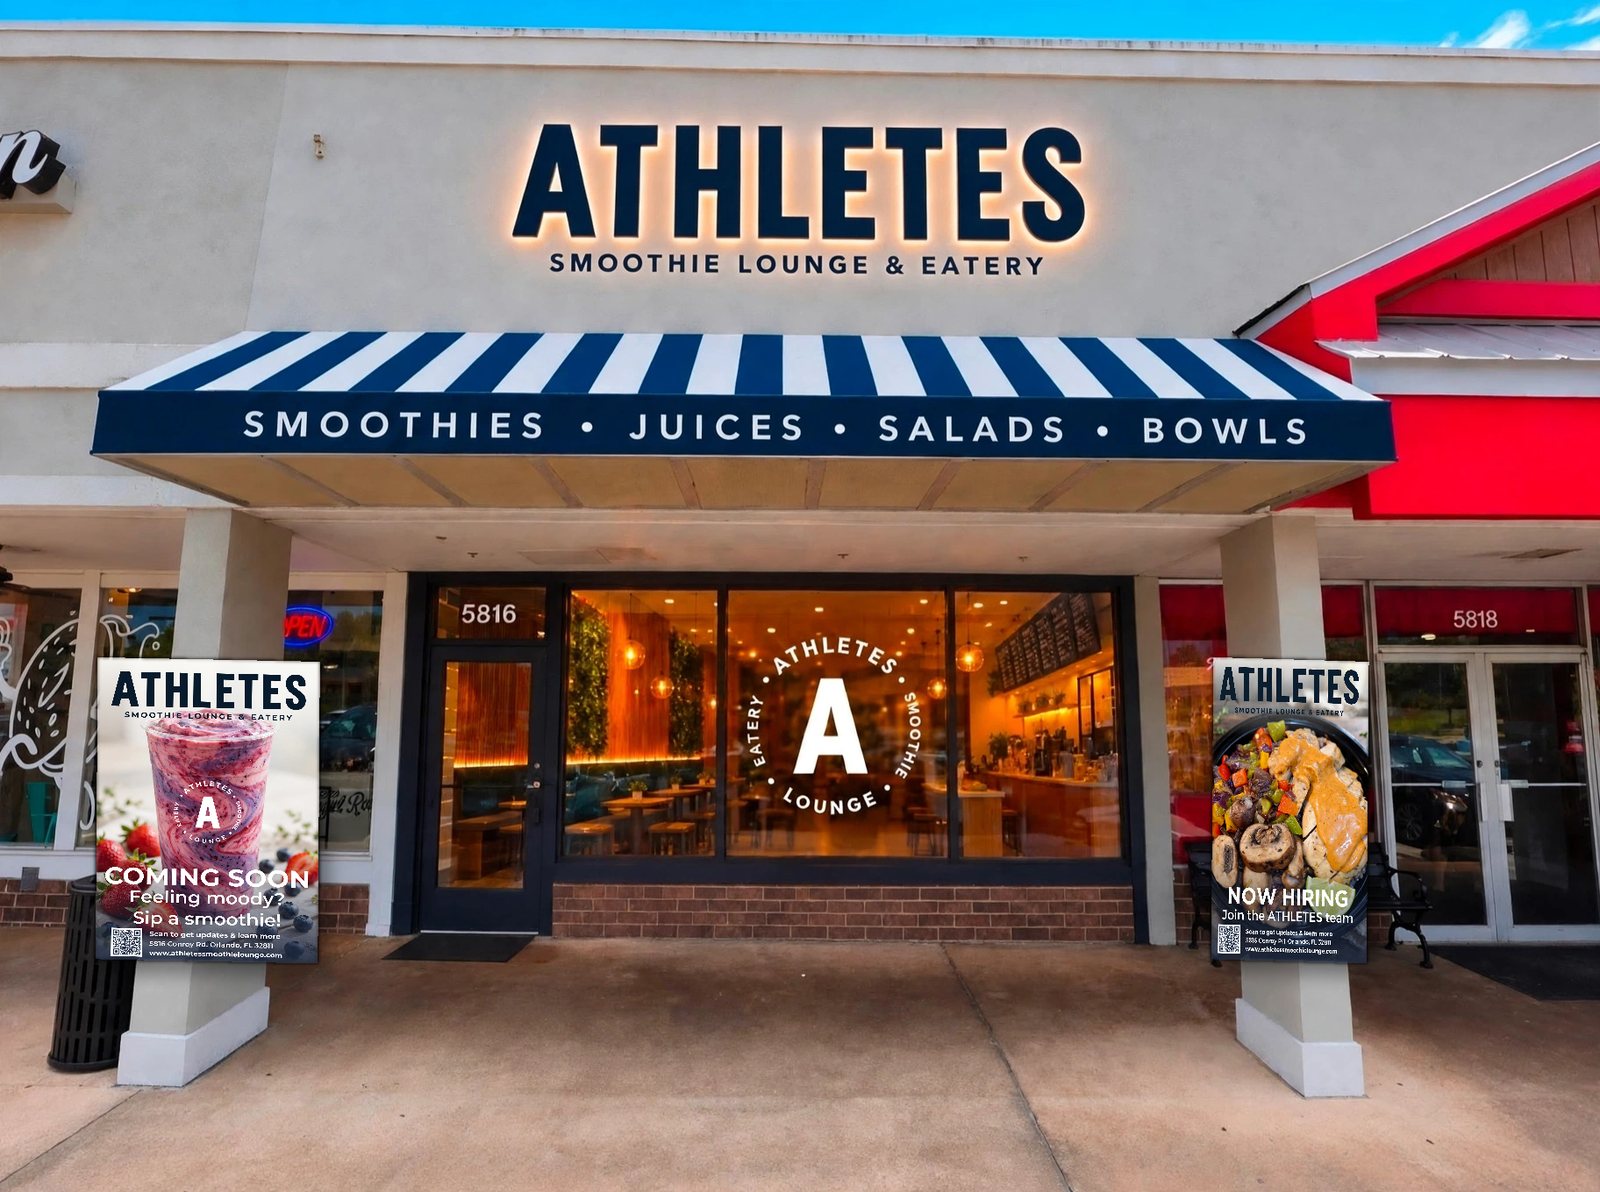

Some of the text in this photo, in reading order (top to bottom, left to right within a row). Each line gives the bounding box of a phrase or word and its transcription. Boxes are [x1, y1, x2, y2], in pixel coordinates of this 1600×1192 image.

[512, 124, 1085, 242] ATHLETES
[550, 253, 1043, 275] SMOOTHIE LOUNGE & EATERY
[243, 410, 1307, 445] SMOOTHIES JUICES SALADS BOWLS
[462, 603, 517, 624] 5816
[1453, 610, 1498, 628] 5818
[284, 614, 328, 638] PEN
[773, 637, 897, 675] ATHLETES
[111, 671, 306, 710] ATHLETES
[1219, 667, 1359, 705] ATHLETES
[124, 711, 182, 719] SMOOTHIE
[188, 712, 233, 720] LOUNGE
[793, 678, 868, 774] A
[747, 695, 766, 767] EATERY
[895, 692, 921, 779] SMOOTHIE
[183, 781, 233, 795] ATHLETES
[195, 796, 221, 829] A
[783, 787, 876, 815] LOUNGE
[104, 866, 309, 889] COMING SOON
[130, 890, 285, 909] Feeling moody?
[1228, 886, 1348, 908] NOW HIRING
[133, 911, 281, 928] Sip a smoothie!
[1221, 909, 1354, 924] Join the ATHLETES team
[181, 932, 194, 940] get
[196, 931, 229, 940] updates
